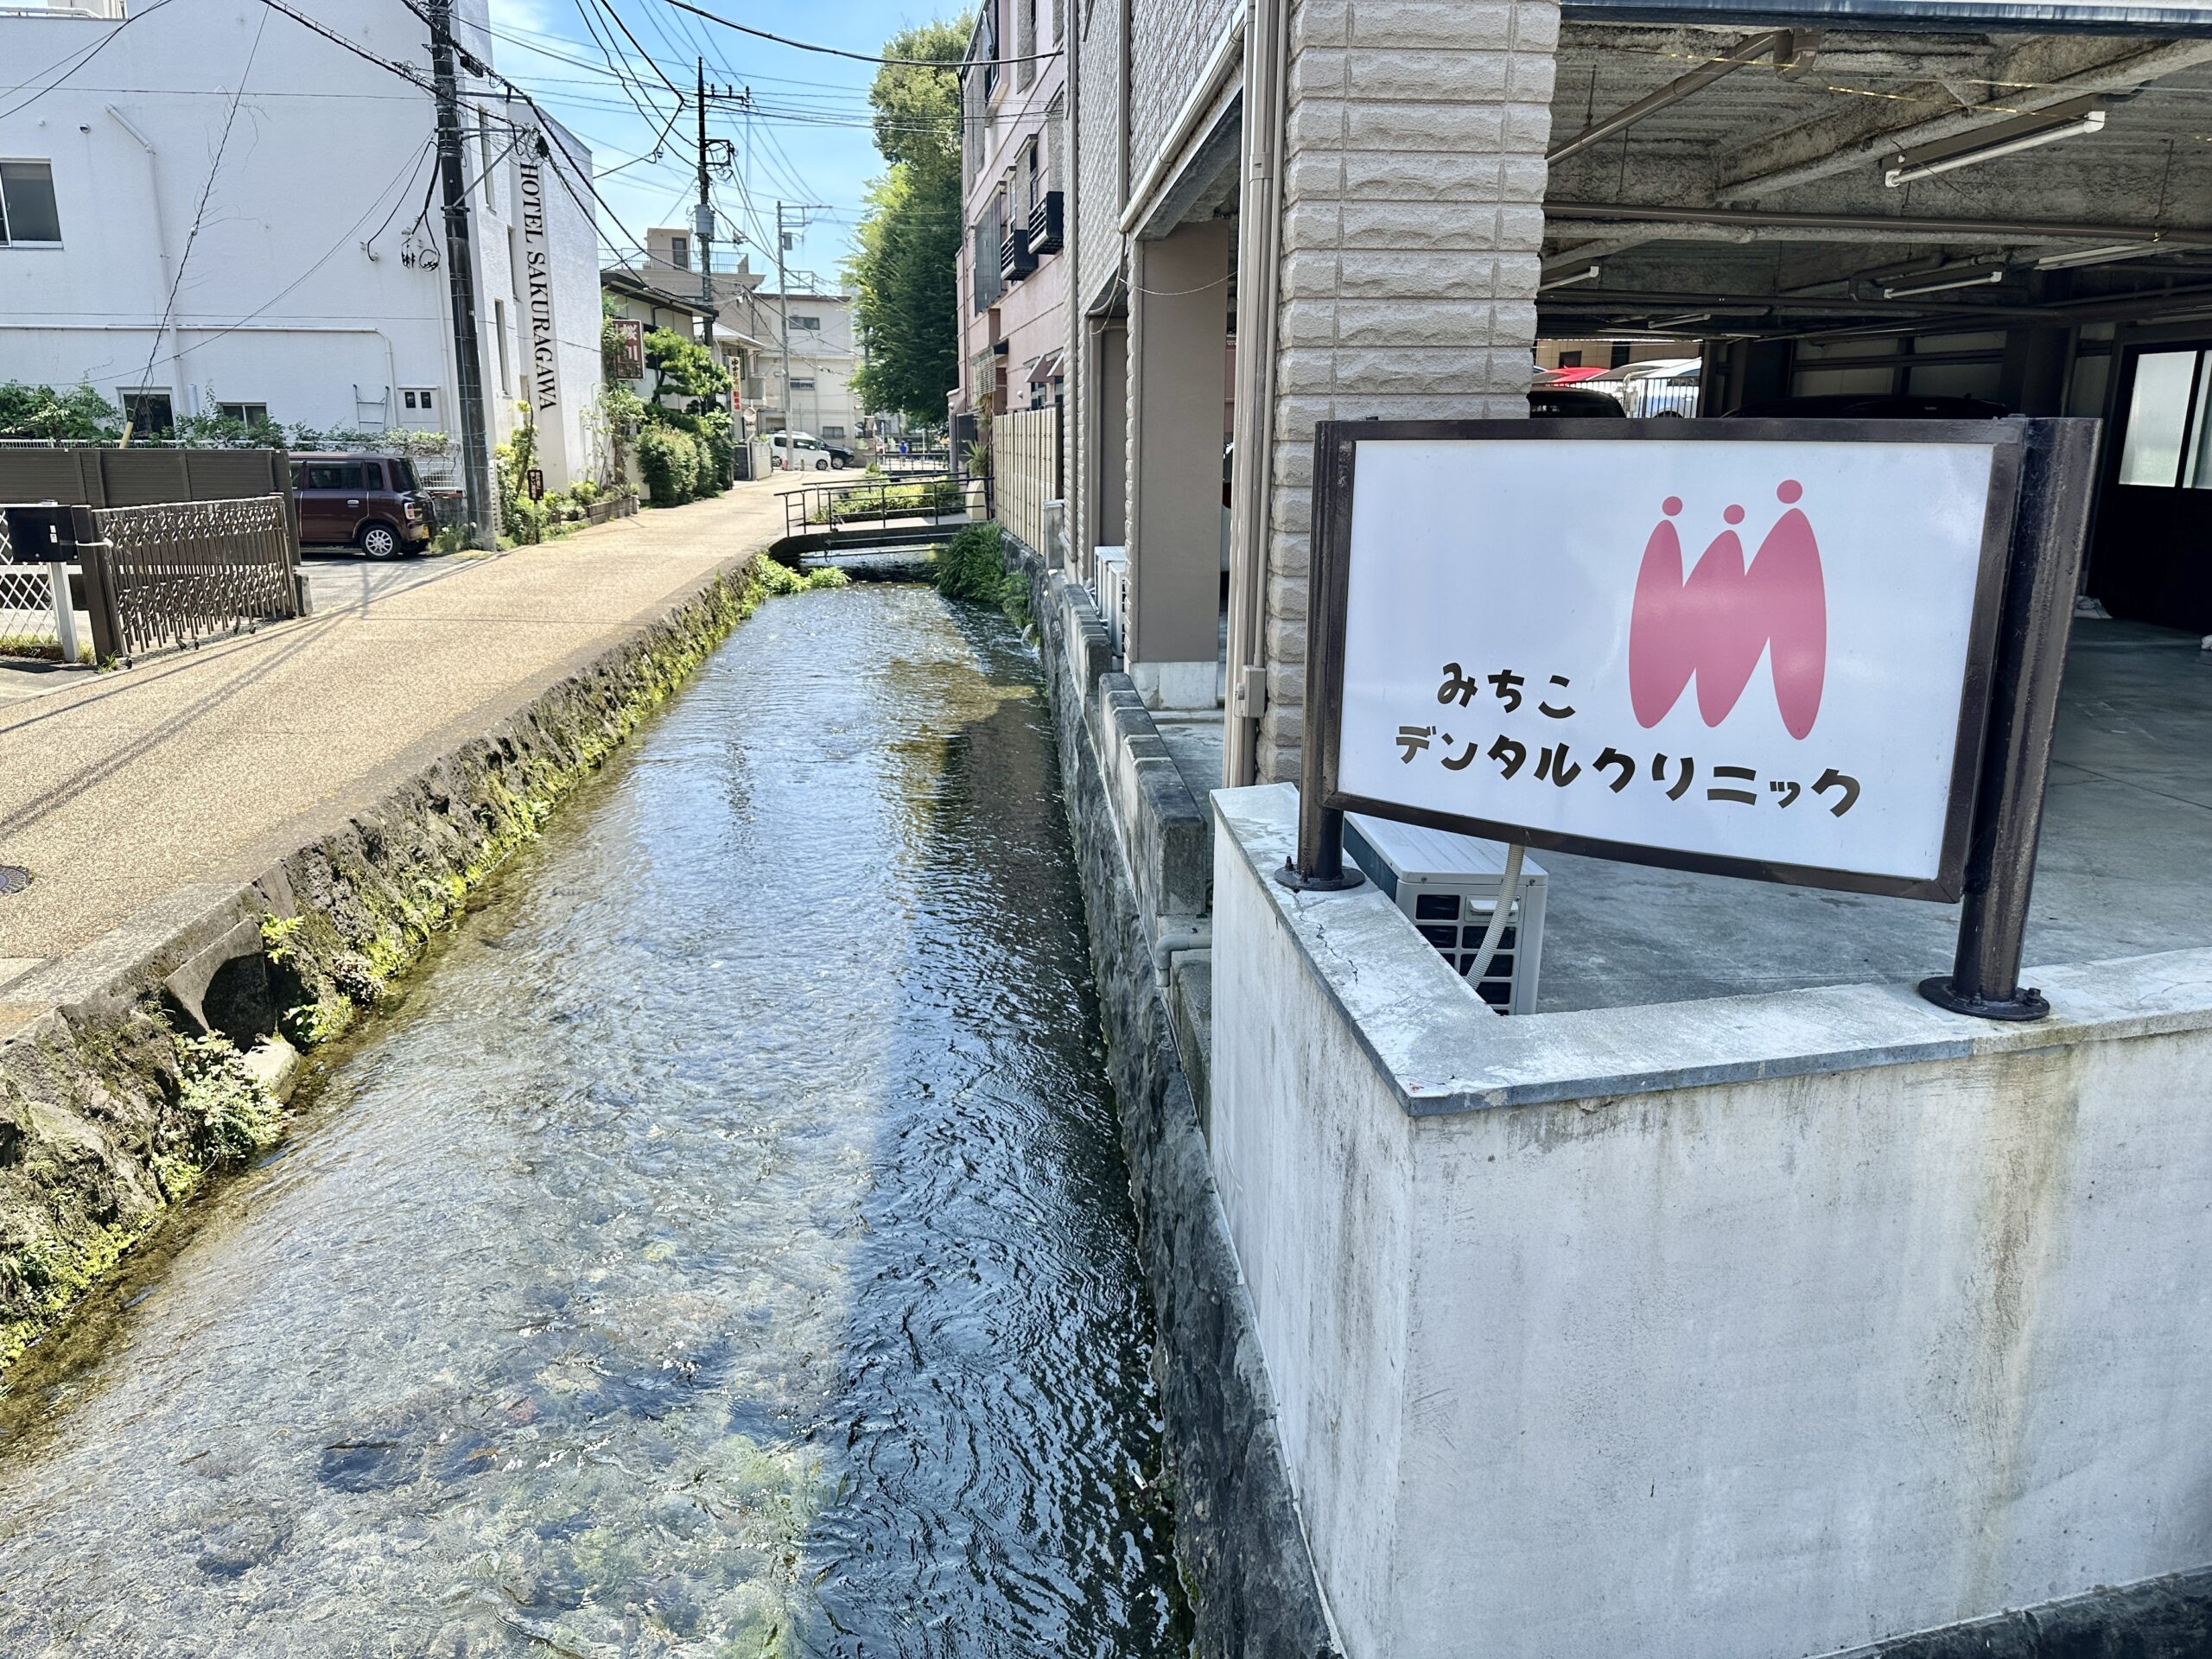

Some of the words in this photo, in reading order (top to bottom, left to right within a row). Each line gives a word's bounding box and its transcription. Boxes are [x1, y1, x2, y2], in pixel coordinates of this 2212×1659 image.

[519, 161, 543, 244] HOTEL
[526, 251, 557, 412] SAKURAGAWA
[1437, 662, 1576, 719] みちこ
[1395, 725, 1860, 818] デンタルクリニック
